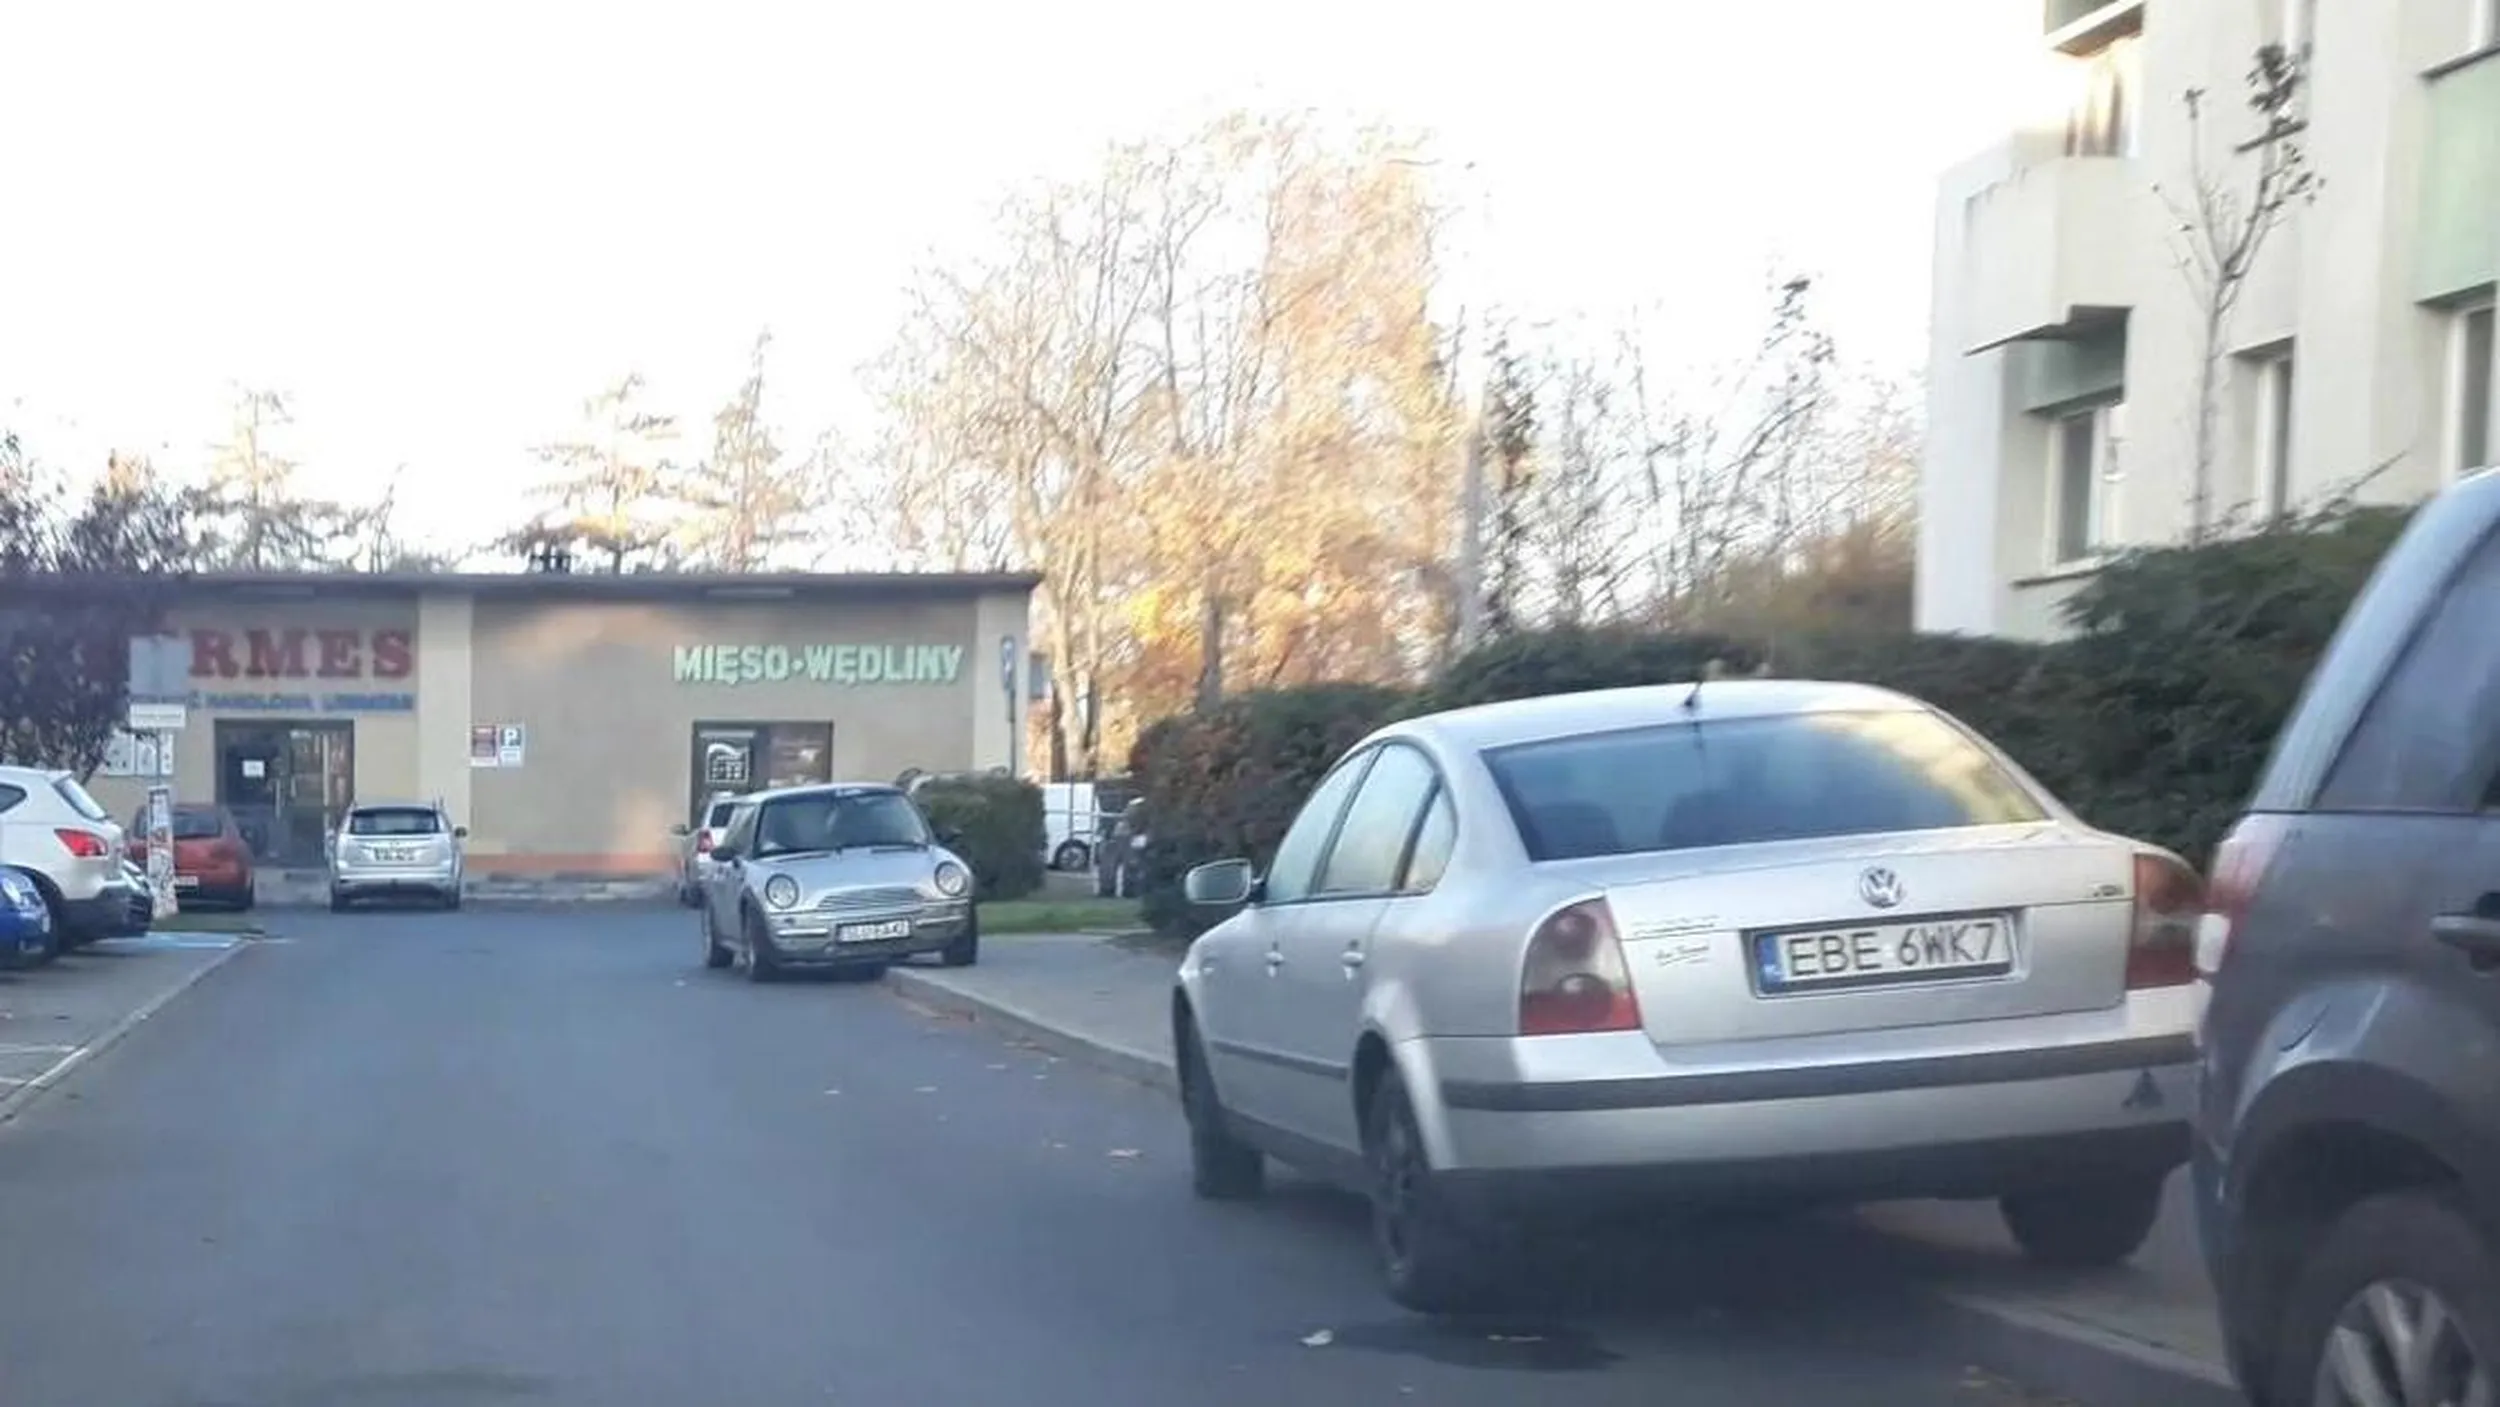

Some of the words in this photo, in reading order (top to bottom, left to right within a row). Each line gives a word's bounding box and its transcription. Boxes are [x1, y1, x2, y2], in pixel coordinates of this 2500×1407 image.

[188, 629, 414, 679] RMES
[1787, 932, 1883, 976] EBE
[1897, 922, 1998, 967] 6WK7
